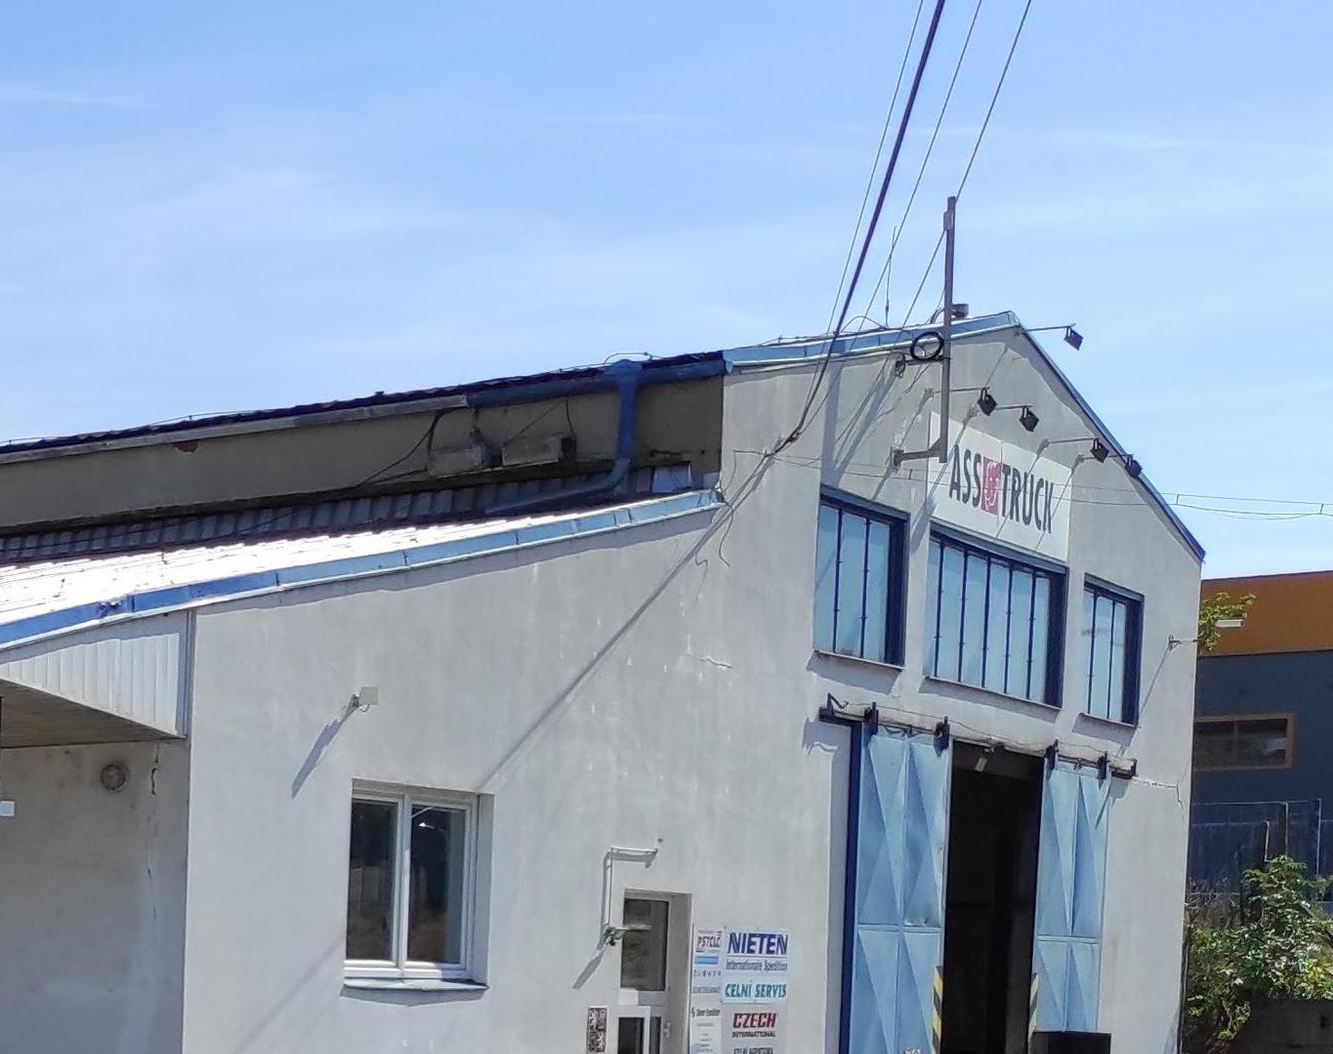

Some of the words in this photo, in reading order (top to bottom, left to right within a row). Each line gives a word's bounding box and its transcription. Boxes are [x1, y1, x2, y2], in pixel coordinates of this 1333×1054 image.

[1001, 462, 1054, 534] TRUCK
[727, 931, 789, 955] NIETEN
[725, 979, 753, 998] CELNÍ
[754, 983, 787, 998] SERVIS
[733, 1012, 776, 1029] CZECH
